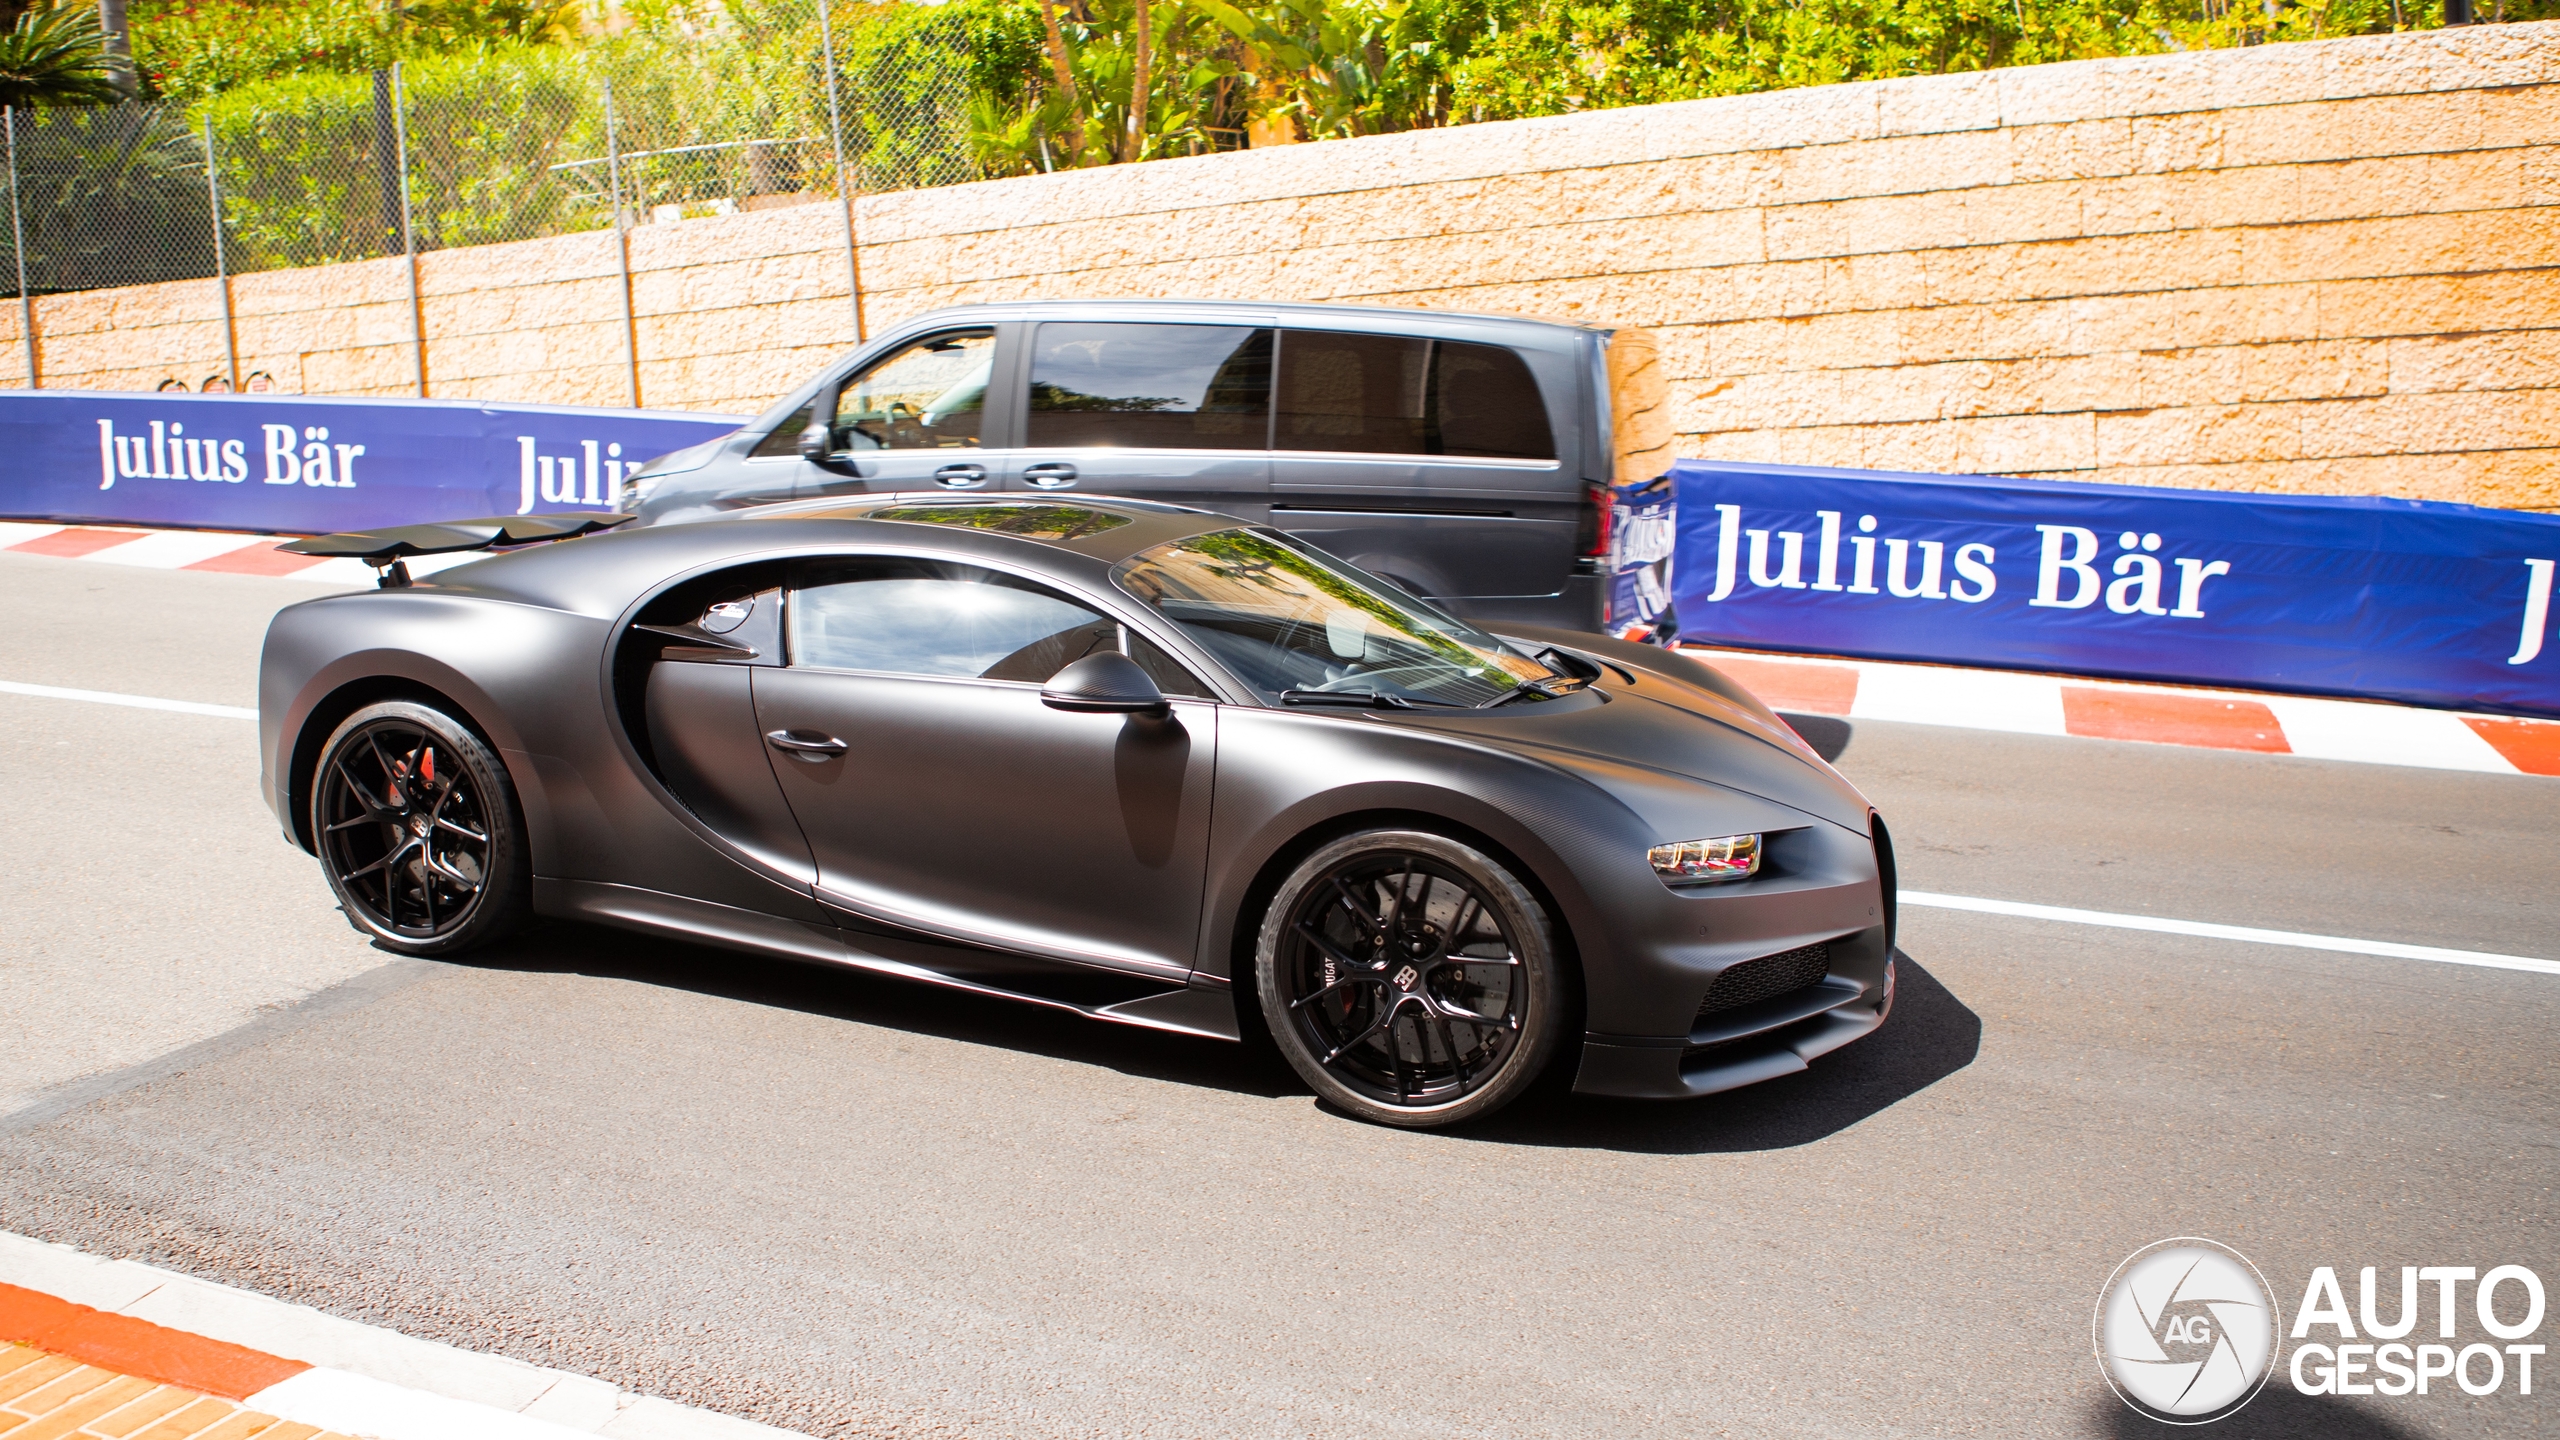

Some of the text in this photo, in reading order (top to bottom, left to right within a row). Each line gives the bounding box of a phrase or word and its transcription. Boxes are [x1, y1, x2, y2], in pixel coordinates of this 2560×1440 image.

[97, 418, 365, 491] Julius Bär
[516, 435, 643, 515] Juli
[1707, 503, 1997, 603] Julius
[2029, 524, 2231, 618] Bär
